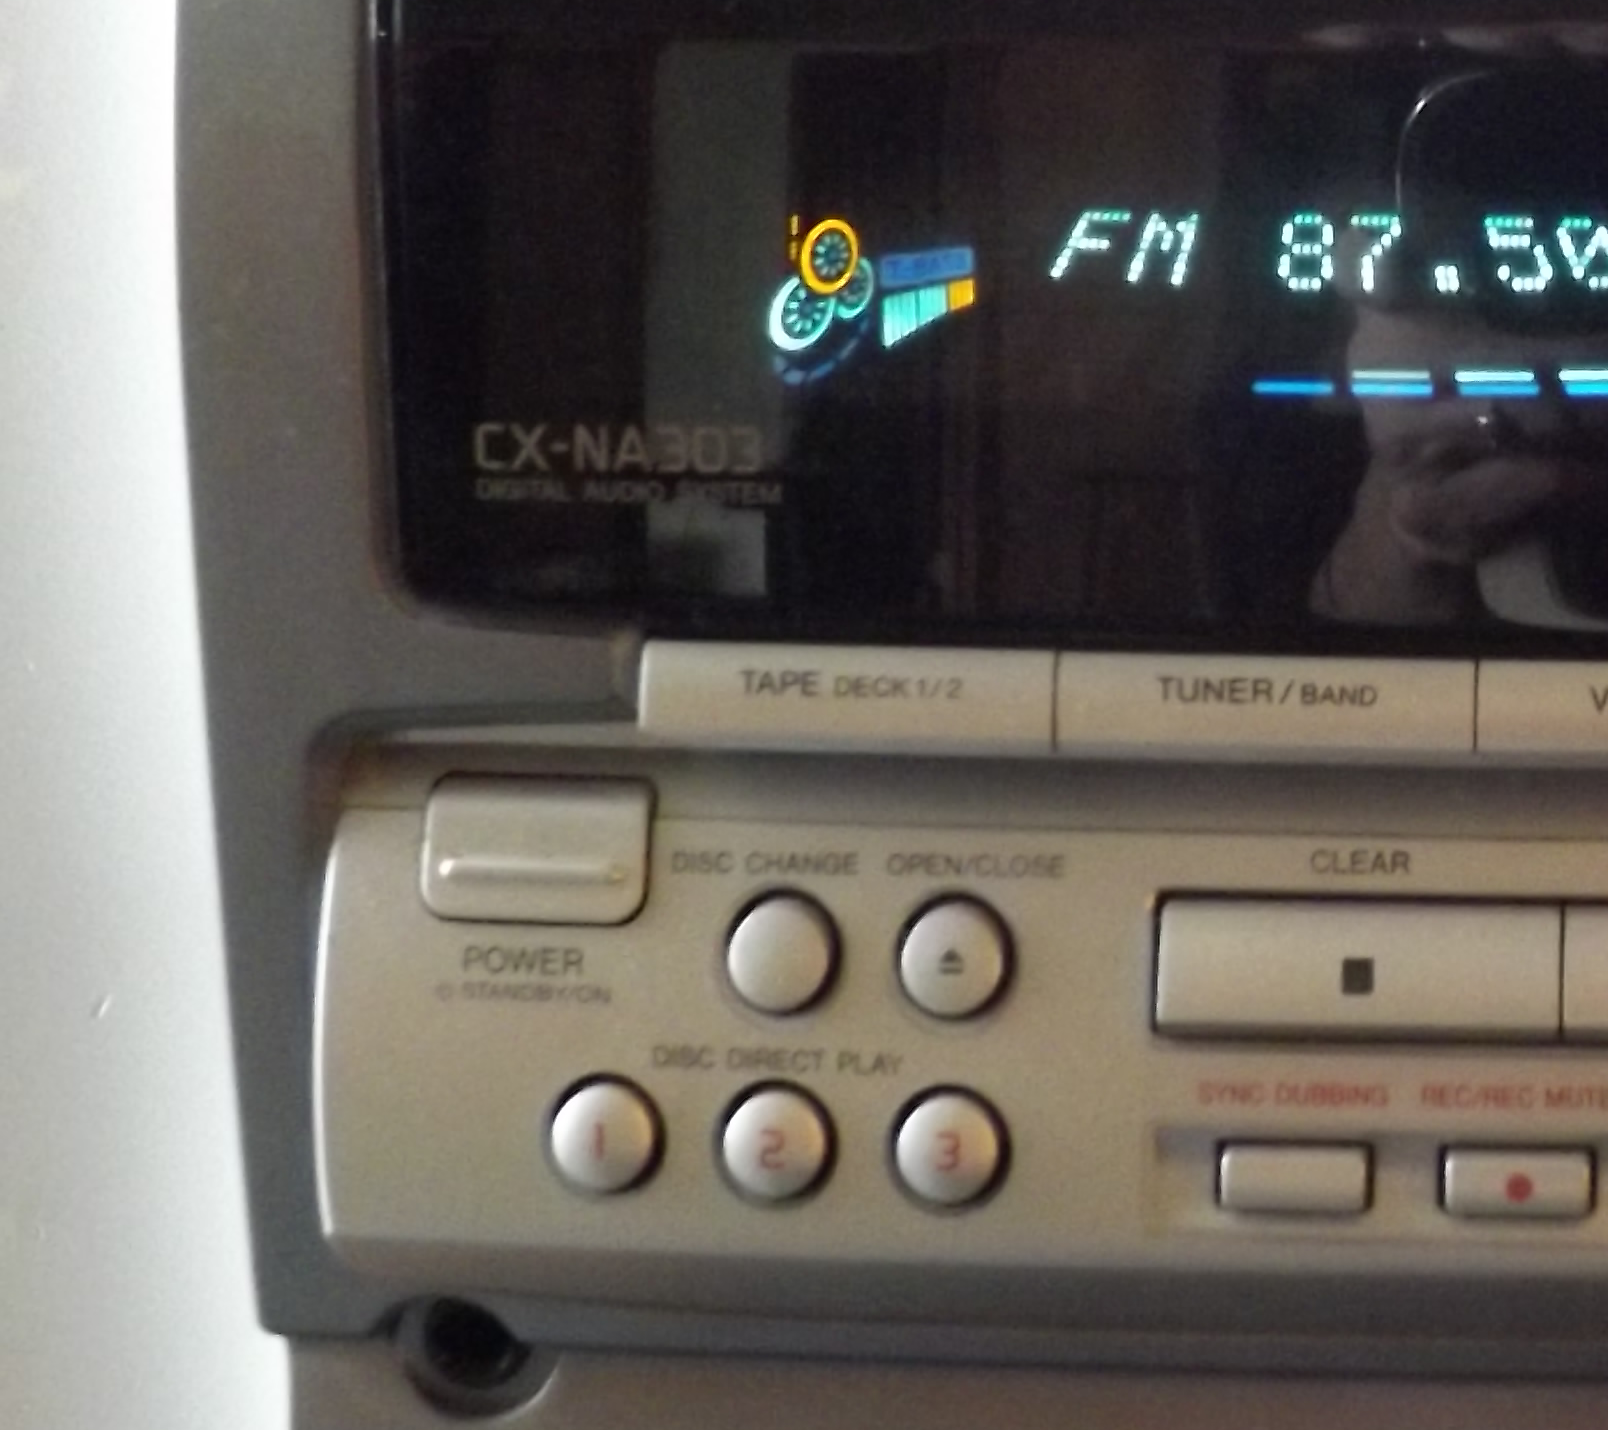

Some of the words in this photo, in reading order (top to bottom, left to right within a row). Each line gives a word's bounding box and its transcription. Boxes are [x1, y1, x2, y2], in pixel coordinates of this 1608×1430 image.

[1049, 212, 1201, 287] FM
[472, 422, 763, 473] CX-NA303
[475, 477, 573, 502] DIGITAL
[582, 479, 665, 503] AUDIO
[675, 479, 784, 507] SYSTEM
[741, 670, 820, 697] TAPE
[833, 674, 909, 699] DECK
[917, 676, 964, 700] 1/2
[671, 850, 733, 875] DISC
[744, 851, 860, 876] CHANGE
[886, 853, 1067, 878] OPEN/CLOSE
[1310, 849, 1410, 875] CLEAR
[463, 945, 585, 975] POWER
[652, 1046, 715, 1070] DISC
[726, 1047, 824, 1073] DIRECT
[836, 1050, 904, 1076] PLAY
[1199, 1082, 1264, 1106] SYNC
[1275, 1082, 1390, 1108] DUBBING
[1420, 1084, 1534, 1110] REC/REC
[593, 1122, 606, 1160] 1
[759, 1128, 785, 1170] 2
[935, 1131, 963, 1172] 3
